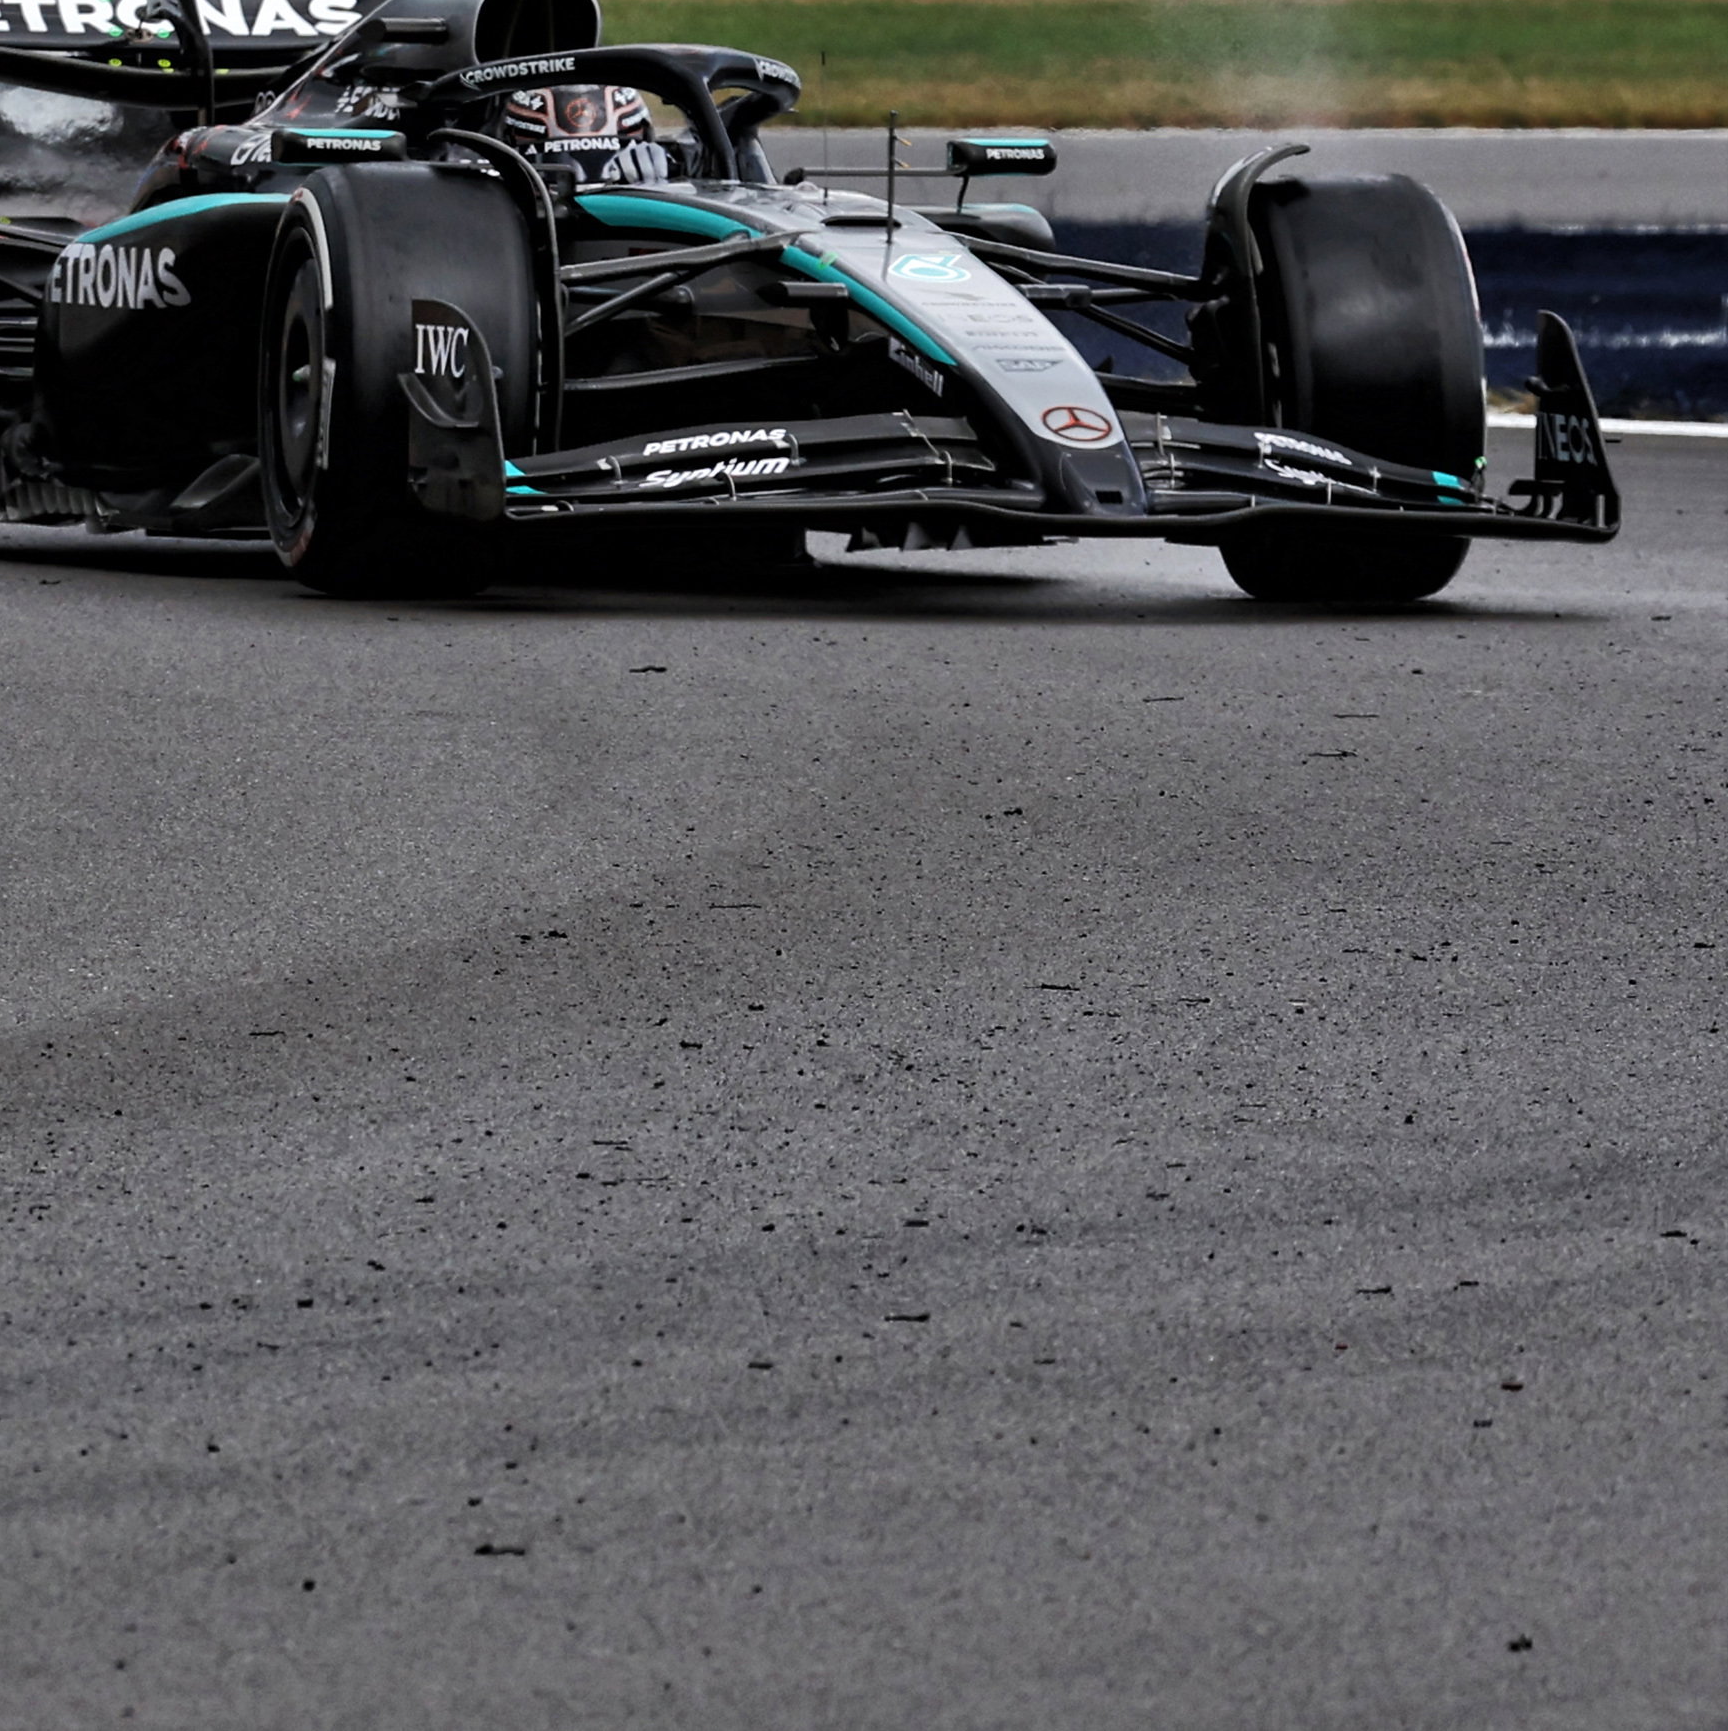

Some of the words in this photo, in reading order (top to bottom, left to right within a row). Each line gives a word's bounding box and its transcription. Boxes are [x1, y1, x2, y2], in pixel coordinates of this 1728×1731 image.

[462, 57, 576, 85] CROWDSTRIKE
[306, 137, 381, 151] PETRONAS
[544, 137, 621, 153] PETRONAS
[985, 147, 1045, 161] PETRONAS
[46, 243, 192, 310] ETRONAS
[414, 323, 470, 378] IWC
[643, 428, 787, 457] PETRONAS
[638, 457, 791, 488] Syntium
